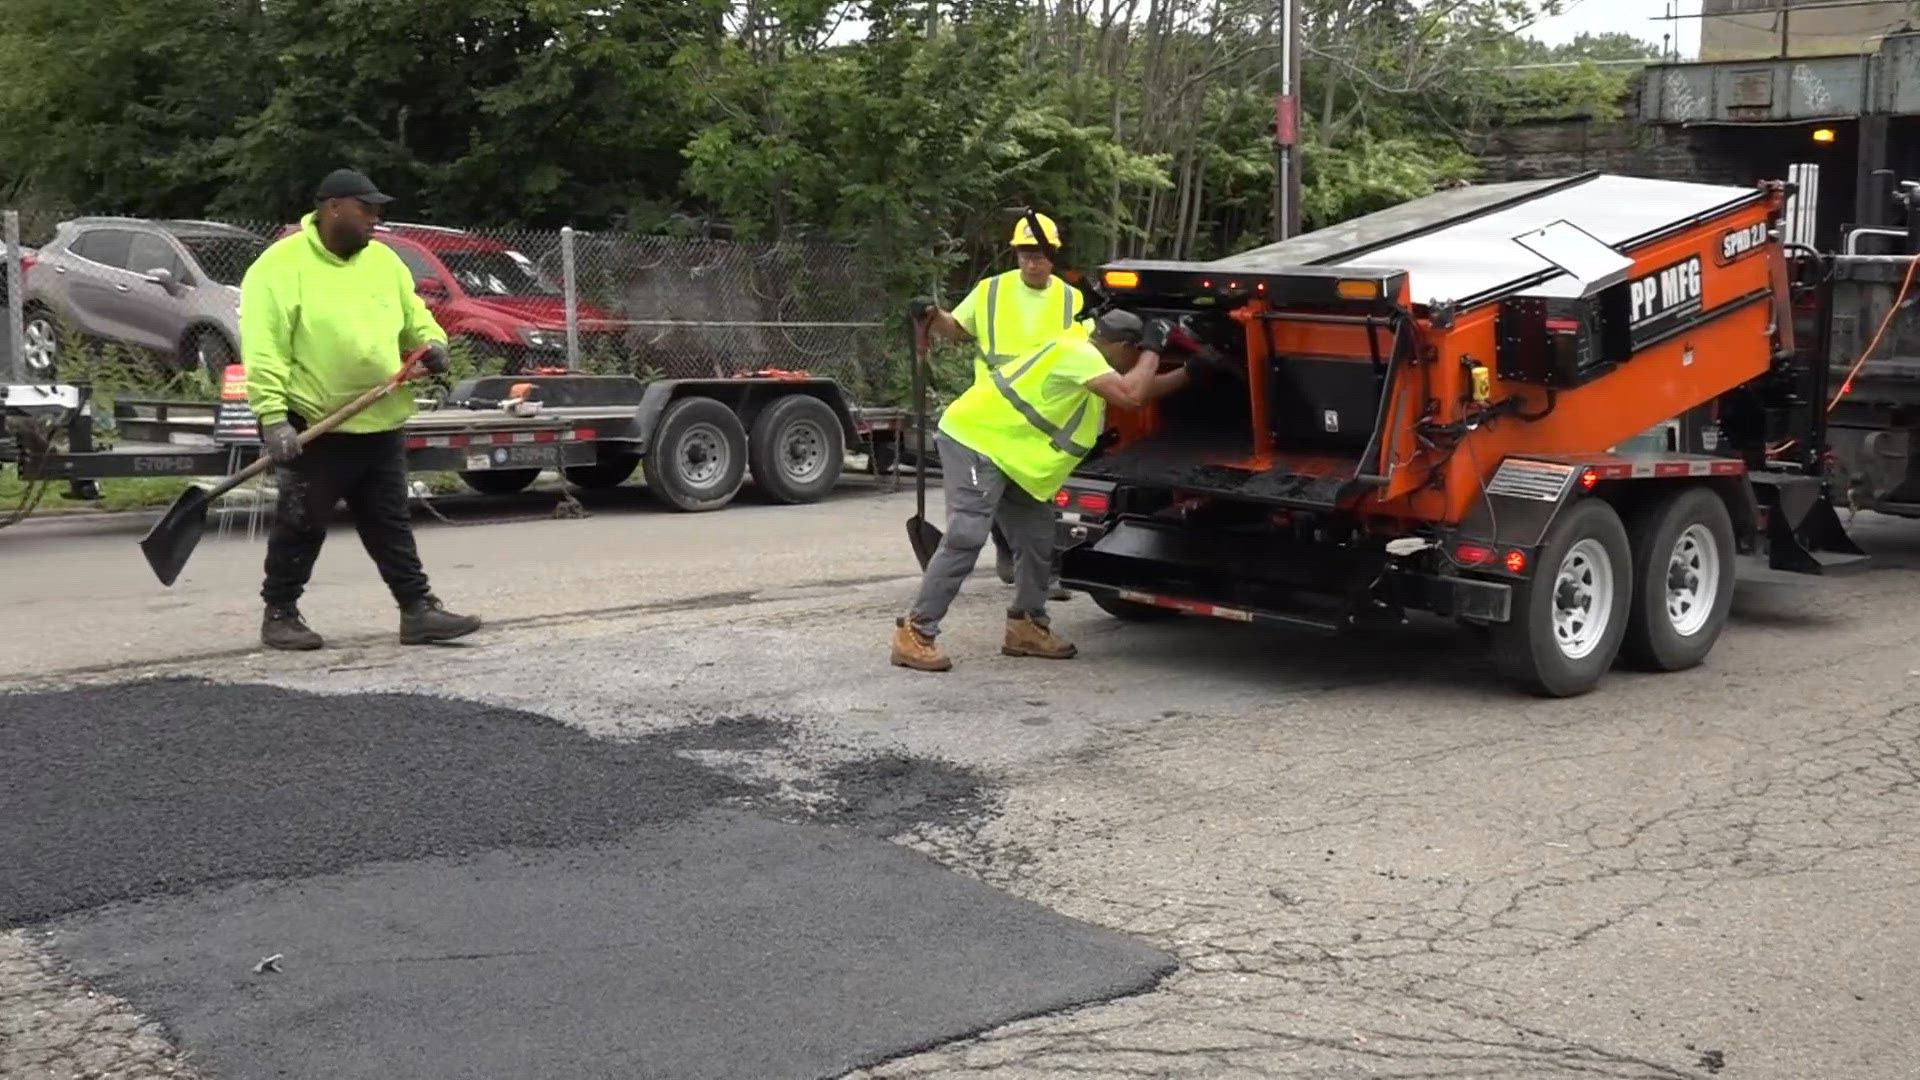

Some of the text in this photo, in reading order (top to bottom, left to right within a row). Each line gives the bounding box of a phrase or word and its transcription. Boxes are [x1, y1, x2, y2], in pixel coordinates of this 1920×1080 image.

[1751, 222, 1767, 246] 2.0
[1630, 277, 1656, 321] PP
[1661, 258, 1700, 308] MFG
